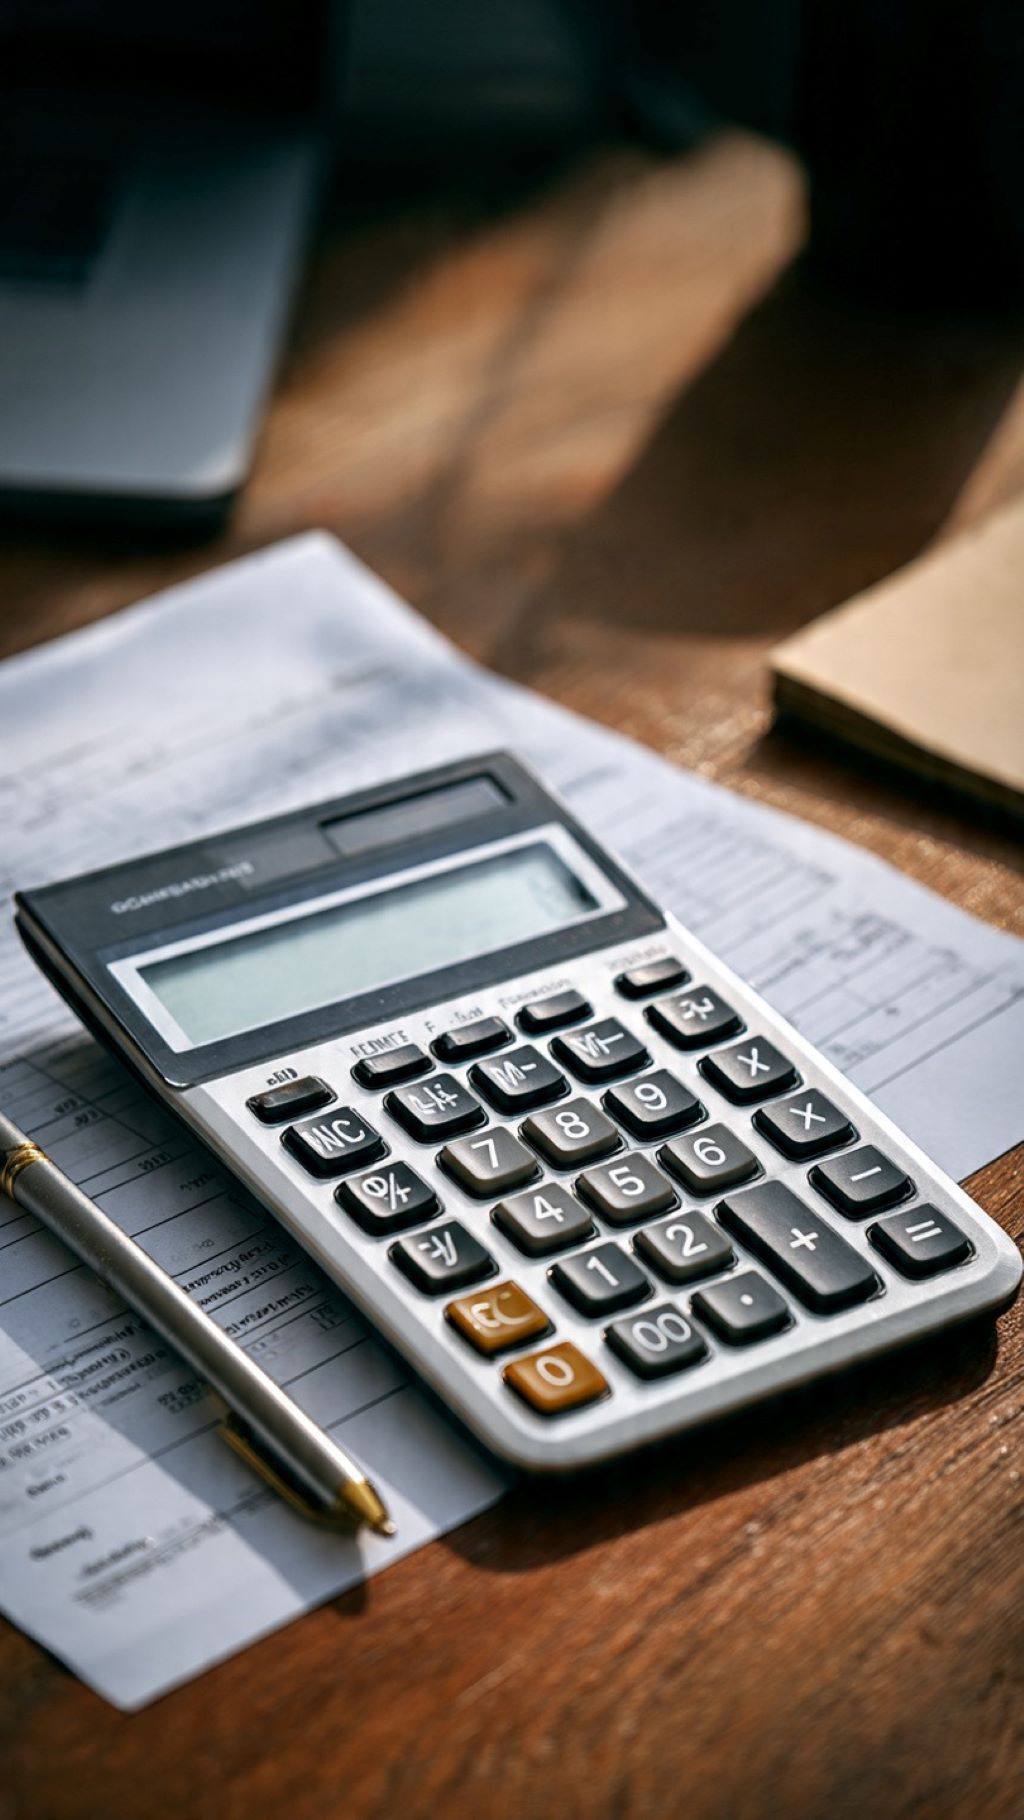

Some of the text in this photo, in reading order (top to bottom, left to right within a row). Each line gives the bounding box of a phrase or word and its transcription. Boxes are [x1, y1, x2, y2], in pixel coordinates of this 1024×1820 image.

[633, 1083, 667, 1111] 9
[554, 1110, 590, 1139] 8
[471, 1138, 499, 1169] 7
[692, 1138, 726, 1167] 6
[608, 1166, 645, 1196] 5
[533, 1195, 564, 1224] 4
[665, 1223, 708, 1258] 2
[587, 1255, 619, 1287] 1
[632, 1312, 692, 1351] 00
[535, 1355, 575, 1386] 0
